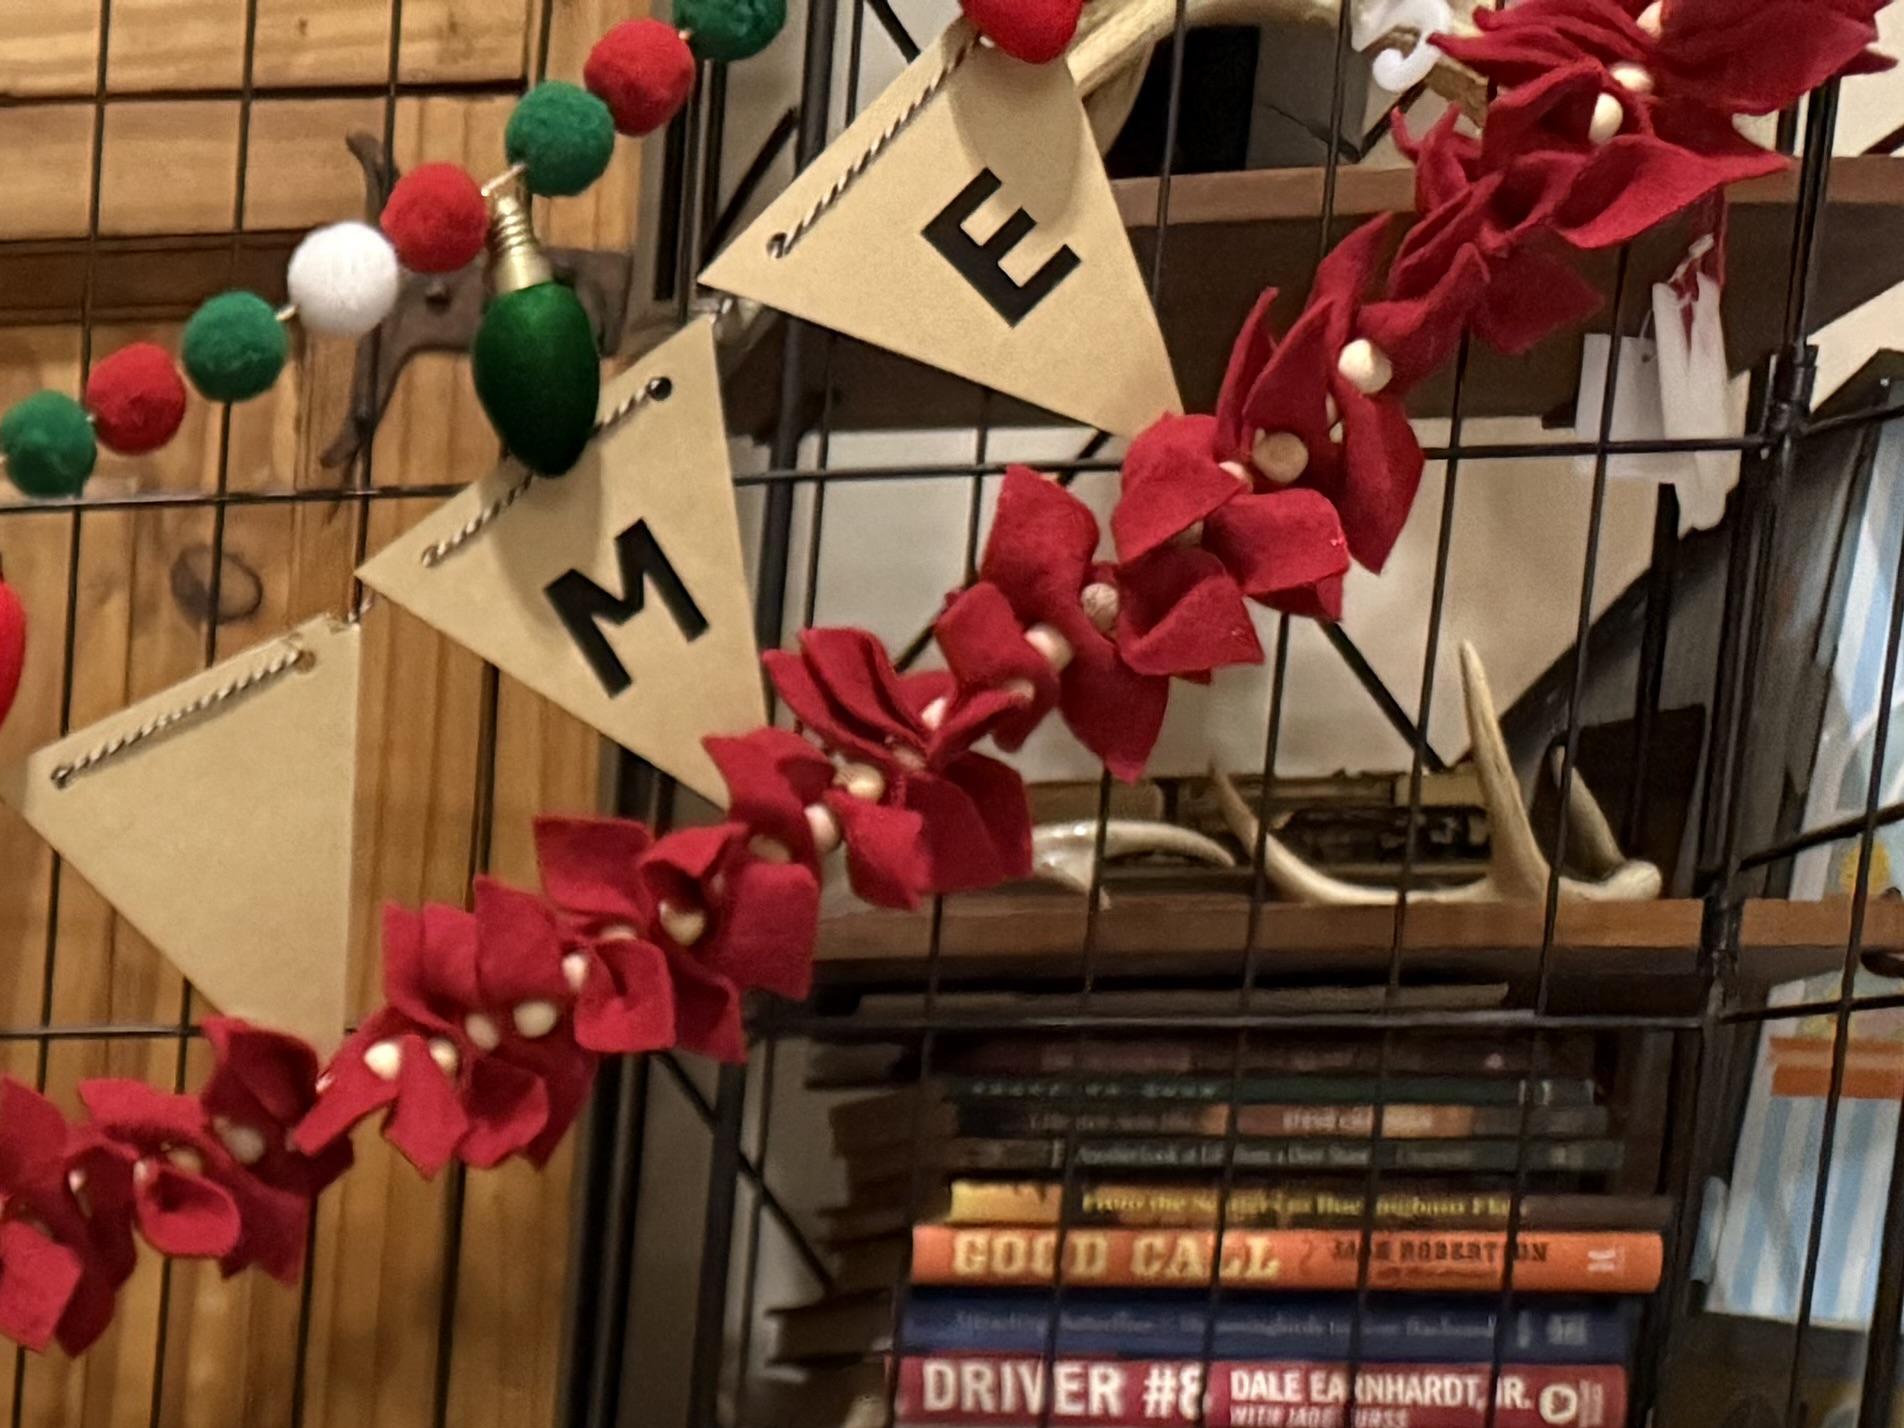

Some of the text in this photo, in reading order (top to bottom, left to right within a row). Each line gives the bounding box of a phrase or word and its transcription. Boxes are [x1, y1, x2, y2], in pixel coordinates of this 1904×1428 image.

[952, 1231, 1110, 1279] GOOD
[1332, 1239, 1548, 1264] JAE ROBERTON
[922, 1360, 1212, 1420] DRIVER #8
[1230, 1370, 1303, 1403] DALE
